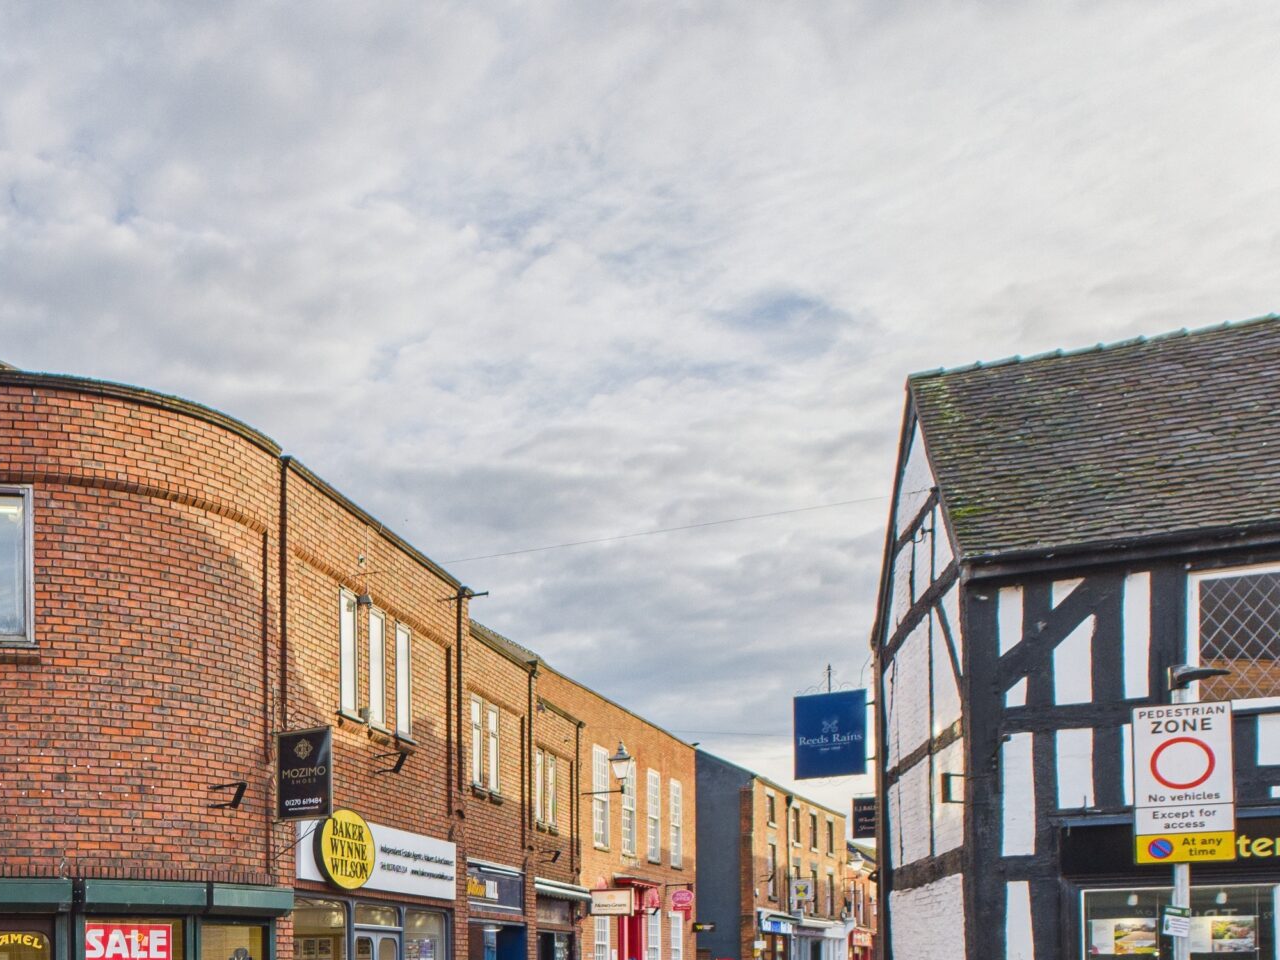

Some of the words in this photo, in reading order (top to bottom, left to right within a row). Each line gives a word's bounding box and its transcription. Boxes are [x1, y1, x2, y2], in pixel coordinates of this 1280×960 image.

[1138, 705, 1225, 719] PEDESTRIAN
[1151, 717, 1213, 734] ZONE
[799, 735, 829, 746] Reeds
[832, 731, 863, 742] Rains
[282, 765, 326, 779] MOZIMO
[1148, 794, 1166, 803] No
[1170, 791, 1221, 801] vehicles
[1152, 809, 1195, 820] Except
[1199, 808, 1217, 817] for
[332, 818, 364, 842] BAKER
[1164, 821, 1206, 830] access
[330, 837, 367, 861] WYNNE
[1182, 838, 1196, 846] At
[1200, 837, 1223, 847] any
[1189, 847, 1216, 856] time
[331, 857, 368, 880] WILSON
[85, 929, 167, 959] SALE
